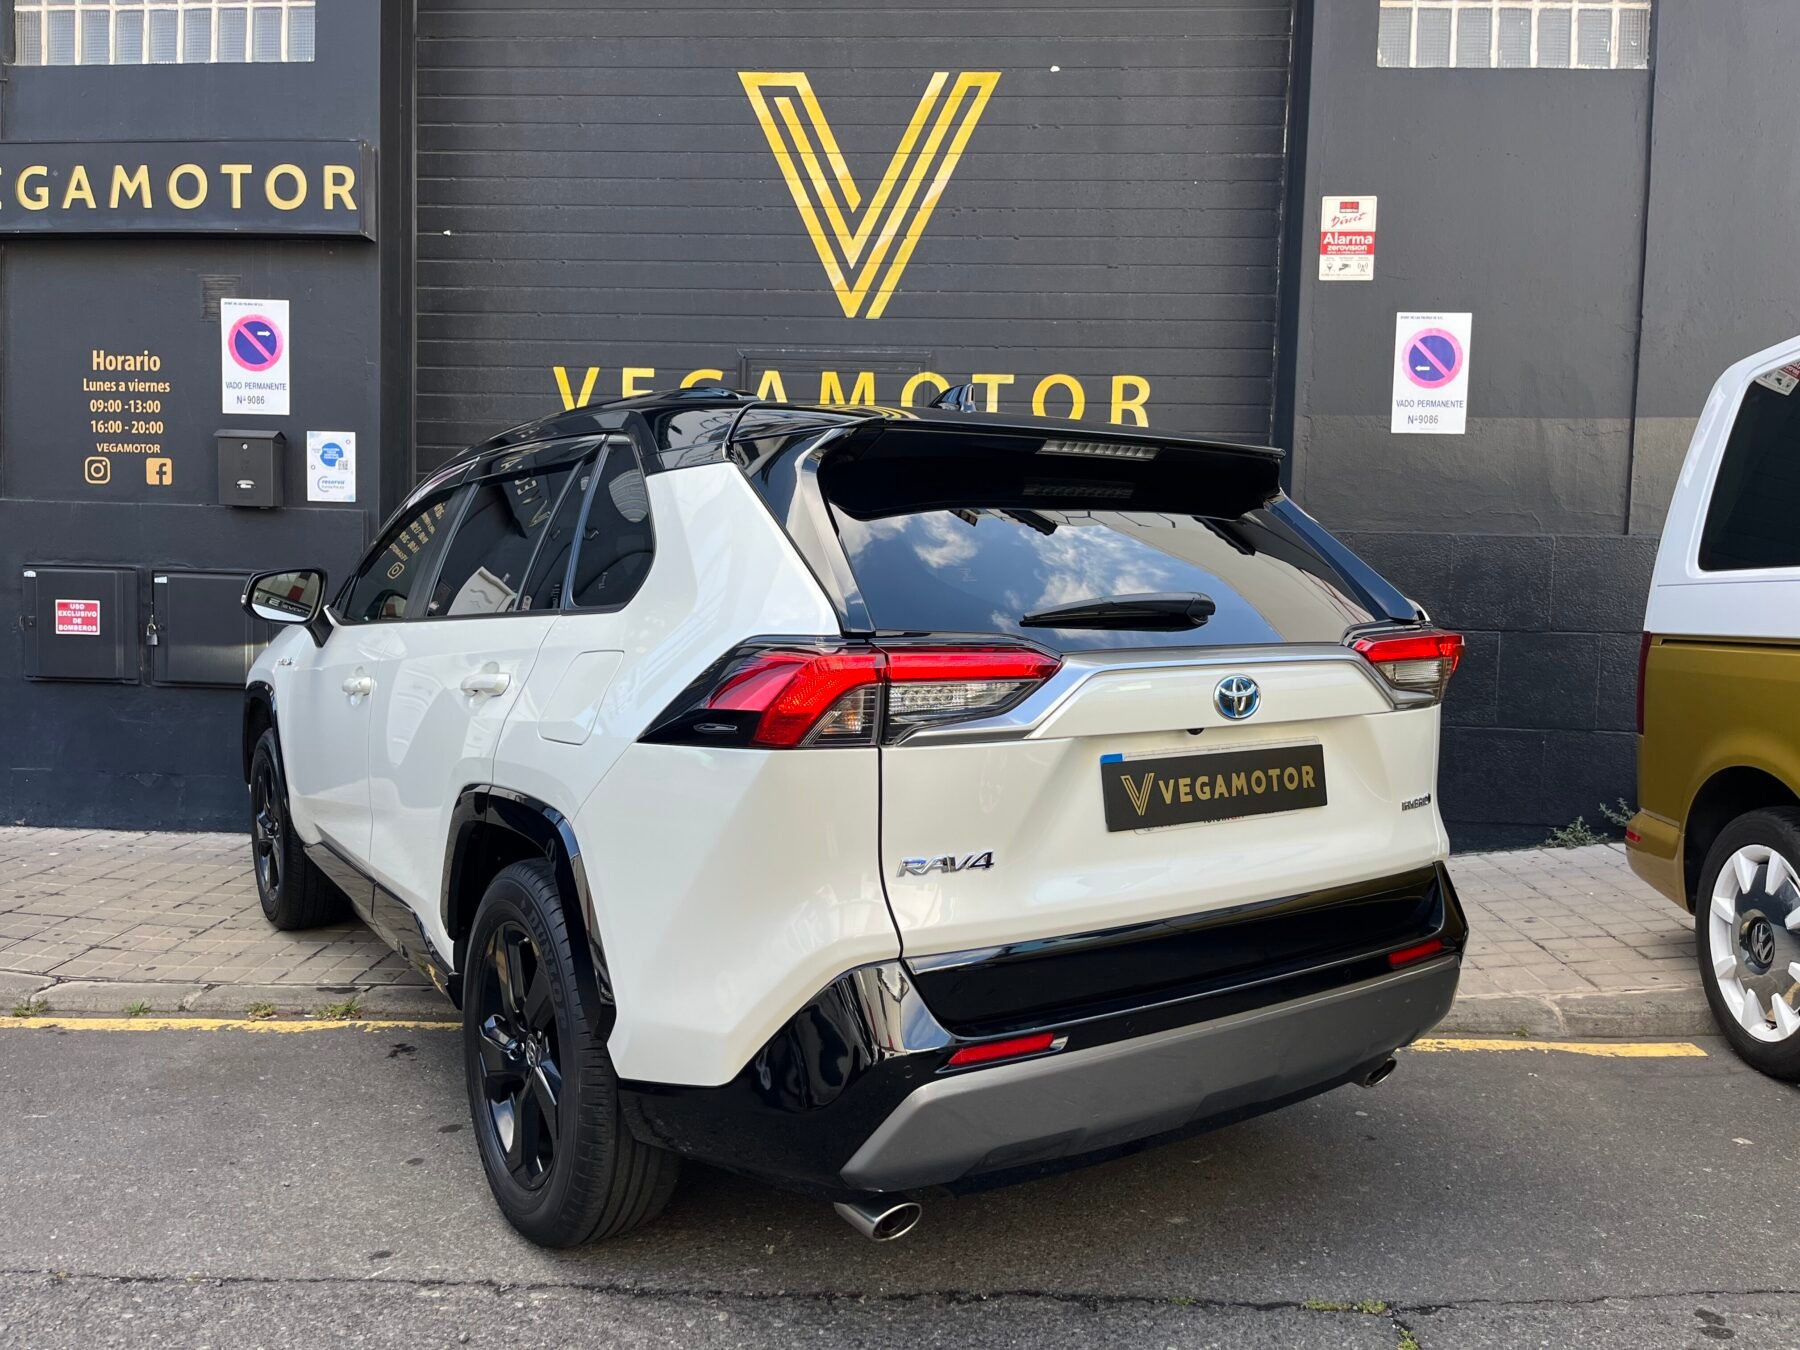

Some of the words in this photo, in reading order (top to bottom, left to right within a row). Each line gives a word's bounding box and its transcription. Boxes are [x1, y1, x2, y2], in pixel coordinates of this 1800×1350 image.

[0, 163, 358, 211] GAMOTOR
[1323, 232, 1373, 244] Alarma
[92, 350, 161, 371] Horario
[83, 378, 117, 391] Lunes
[118, 381, 125, 392] a
[128, 378, 171, 392] viernes
[225, 381, 242, 390] VADO
[244, 382, 287, 391] PERMANENTE
[89, 399, 122, 413] 09:00
[1396, 399, 1415, 408] VADO
[1417, 400, 1464, 408] PERMANENTE
[90, 420, 122, 433] 16:00
[131, 421, 164, 434] 20:00
[96, 442, 161, 454] VEGAMOTOR
[58, 610, 97, 618] EXCLUSIVO
[1158, 765, 1316, 804] VEGAMOTOR
[896, 849, 994, 878] RAV4
